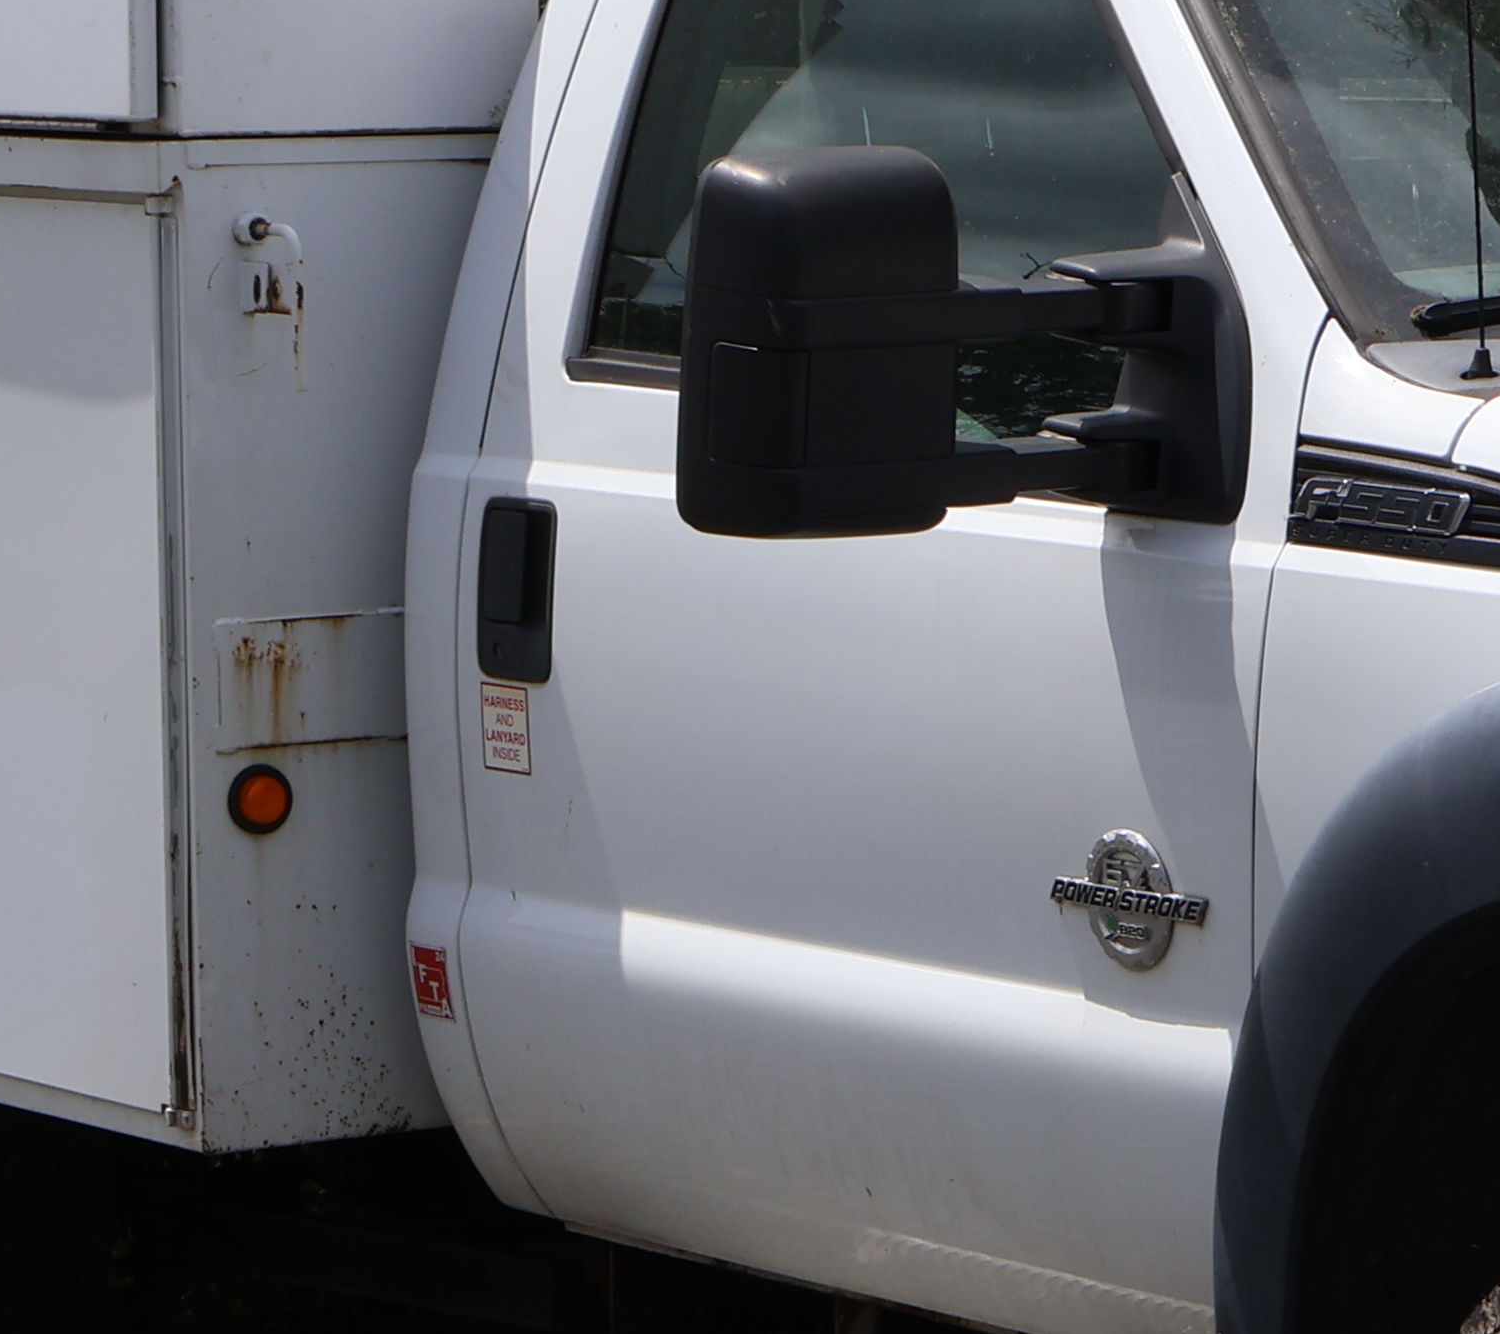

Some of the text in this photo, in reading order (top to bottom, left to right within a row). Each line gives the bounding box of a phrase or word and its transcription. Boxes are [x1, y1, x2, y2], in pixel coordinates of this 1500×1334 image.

[1291, 527, 1455, 555] SUPER DUTY
[483, 694, 525, 713] HARNESS
[495, 714, 514, 727] AND
[485, 728, 526, 746] LANYARD
[492, 746, 521, 763] INSIDE
[1050, 876, 1201, 922] POWER STROKE
[1118, 923, 1147, 940] B20
